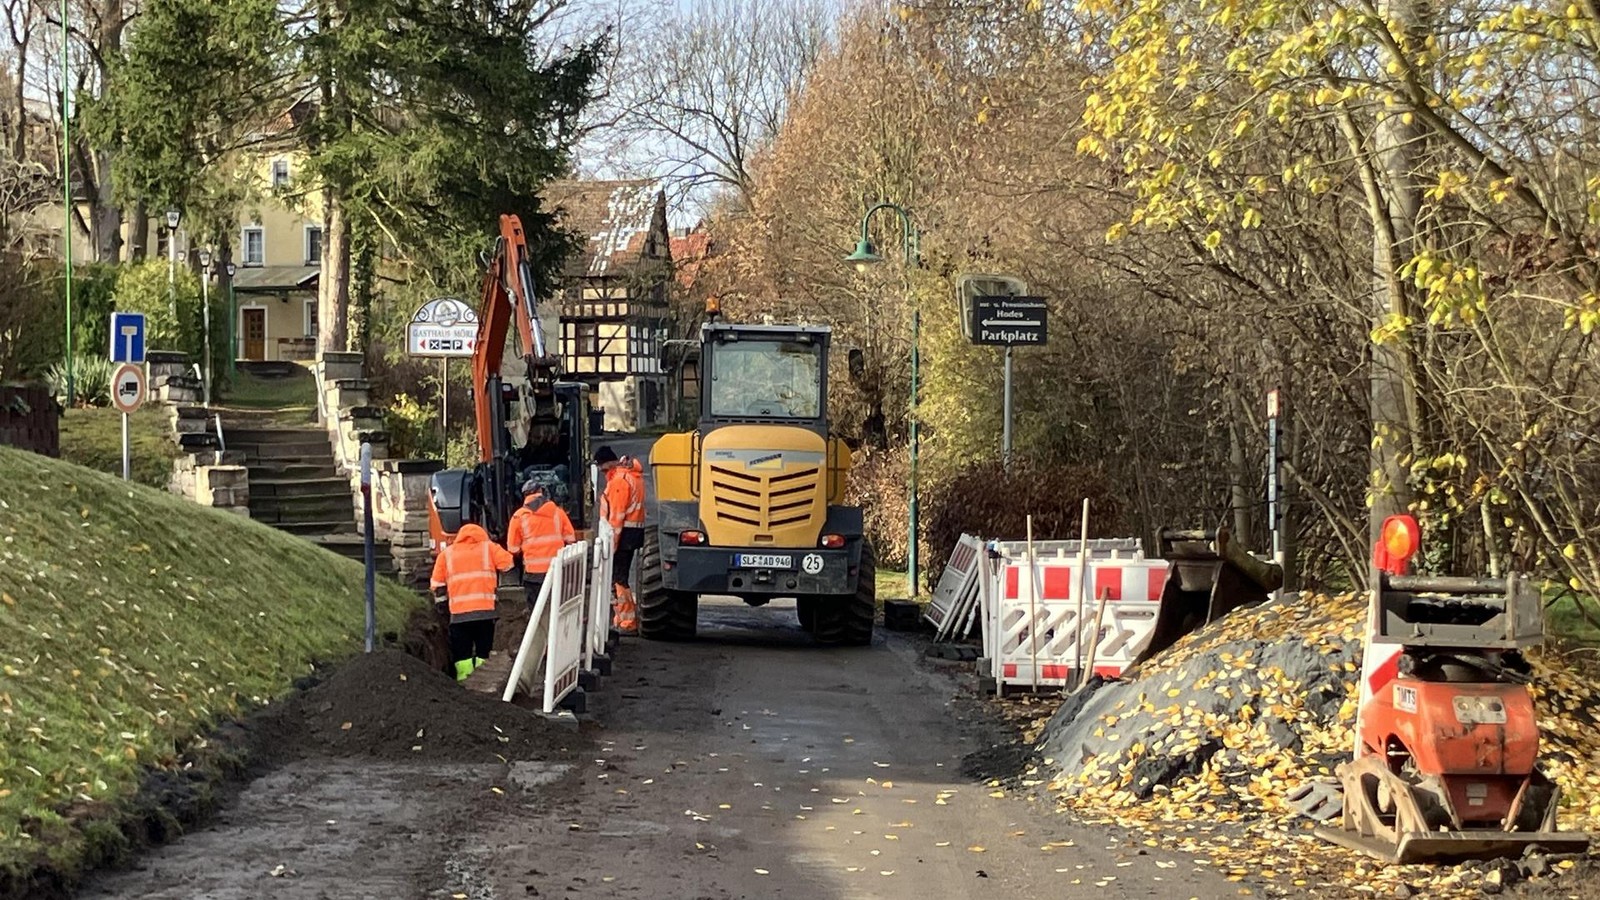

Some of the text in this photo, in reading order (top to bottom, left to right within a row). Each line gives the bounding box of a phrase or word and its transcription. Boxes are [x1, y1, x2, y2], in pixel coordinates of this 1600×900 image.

[996, 310, 1024, 318] Hodes
[412, 329, 451, 338] GASTHAUS
[981, 330, 1039, 343] Parkplatz
[742, 556, 757, 566] SLF
[806, 556, 820, 571] 25
